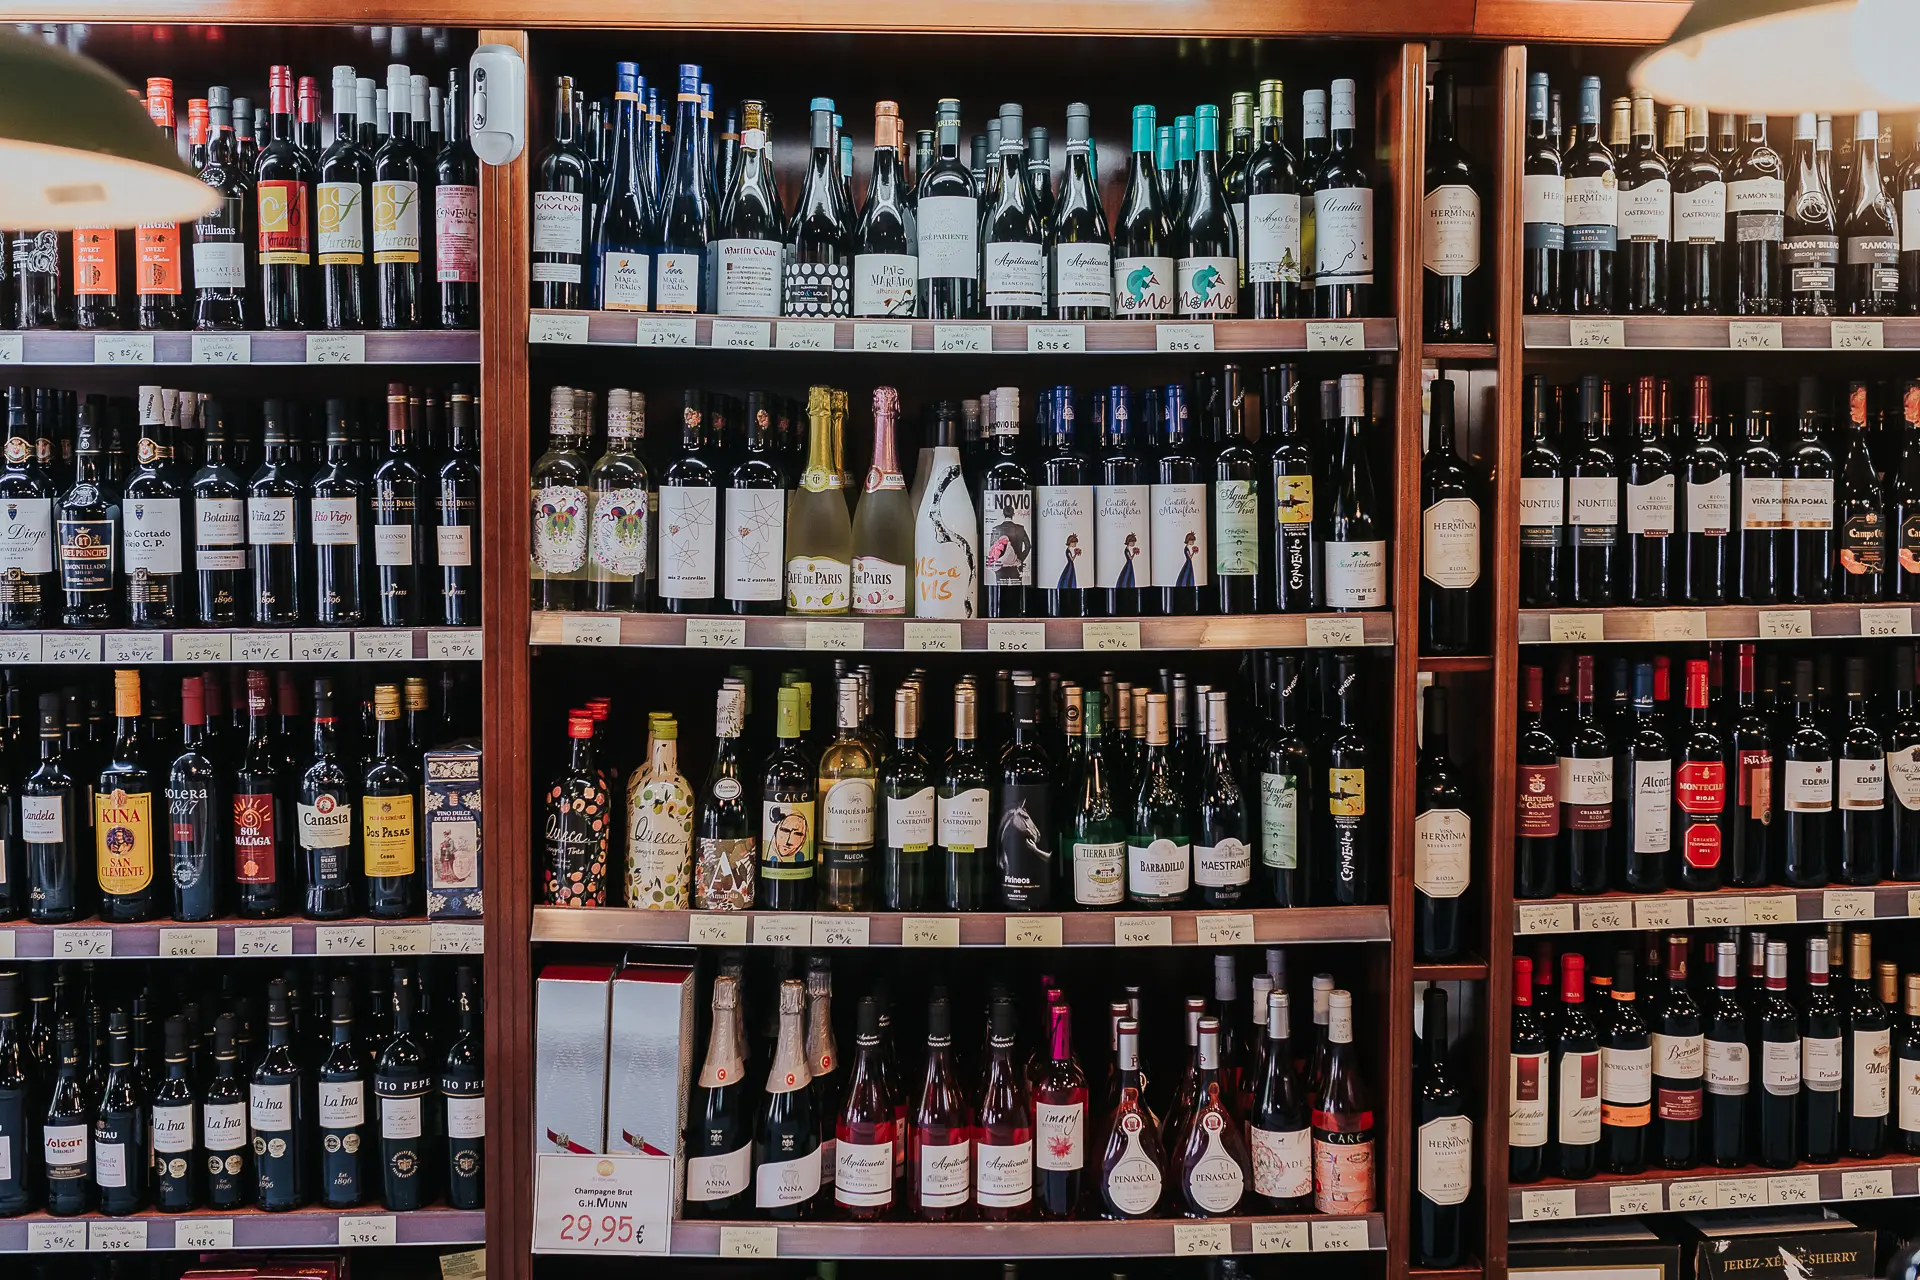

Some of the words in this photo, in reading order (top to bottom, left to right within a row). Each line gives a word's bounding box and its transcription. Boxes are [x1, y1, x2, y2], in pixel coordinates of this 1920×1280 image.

[1566, 194, 1613, 204] HERMINIA
[1624, 209, 1665, 217] CASTROVIEJO
[195, 224, 236, 236] Williams
[933, 233, 969, 242] PARIENTE
[80, 246, 100, 254] SWEET
[1782, 241, 1816, 250] RAMÓN
[1818, 240, 1840, 250] BILBAO
[1860, 241, 1891, 250] RAMÓN
[1037, 341, 1058, 350] 8.95
[994, 493, 1031, 511] NOVIO
[1520, 500, 1560, 509] NUNTIUS
[1577, 499, 1617, 508] NUNTIUS
[1751, 497, 1770, 505] VIÑA
[1782, 497, 1799, 505] VIÑA
[1801, 497, 1828, 505] POMAL
[252, 510, 271, 522] Viña
[273, 510, 286, 522] 25
[1042, 507, 1083, 518] Miraflores
[1100, 507, 1141, 518] Miraflores
[1159, 506, 1200, 517] Miraflores
[203, 512, 240, 526] Botaina
[314, 510, 328, 522] Río
[330, 510, 352, 525] Viejo
[1433, 522, 1477, 532] HERMINIA
[8, 524, 47, 545] Diego
[134, 531, 171, 542] Cortado
[1849, 529, 1874, 540] Campo
[64, 548, 76, 558] DEL
[77, 548, 107, 559] PRINCIPE
[65, 563, 107, 574] AMONTILLADO
[787, 572, 802, 586] CAFÉ
[803, 576, 814, 586] DE
[814, 573, 843, 586] PARIS
[863, 573, 892, 586] PARIS
[1869, 626, 1889, 636] 8.50
[1520, 794, 1553, 803] Marqués
[168, 800, 199, 815] 1847
[827, 806, 860, 816] MARQUÉS
[23, 808, 56, 821] Candela
[101, 808, 141, 823] KINA
[303, 811, 349, 826] Canasta
[897, 817, 933, 825] CASTROVIEJO
[241, 827, 259, 836] SOL
[634, 816, 684, 844] Queca
[235, 836, 271, 846] MÁLAGA
[1421, 832, 1467, 842] HERMINIA
[566, 847, 585, 857] Tinta
[656, 848, 679, 857] Blanca
[109, 857, 131, 867] SAN
[1140, 861, 1185, 872] BARBADILLO
[1201, 860, 1251, 871] MAESTRANTE
[101, 866, 145, 878] CLEMENTE
[1004, 875, 1030, 884] Pirineos
[1604, 1063, 1634, 1071] BODEGAS
[1711, 1073, 1740, 1083] PradoRey
[378, 1080, 397, 1091] TIO
[403, 1078, 431, 1090] PEPE
[252, 1096, 264, 1109] La
[265, 1098, 283, 1110] Ina
[323, 1095, 337, 1107] La
[340, 1095, 359, 1107] Ina
[154, 1118, 167, 1131] La
[167, 1118, 185, 1131] Ina
[207, 1118, 221, 1129] La
[223, 1117, 242, 1129] Ina
[1044, 1109, 1081, 1136] imary
[45, 1137, 83, 1149] Solear
[1428, 1138, 1471, 1149] HERMINIA
[840, 1154, 886, 1168] Azpilicueta
[334, 1177, 352, 1185] 1896
[1114, 1173, 1157, 1183] PEÑASCAL
[1196, 1171, 1238, 1182] PEÑASCAL
[574, 1186, 616, 1197] Champagne
[617, 1187, 633, 1197] Brut
[560, 1214, 633, 1246] 29,95
[635, 1224, 645, 1244] €
